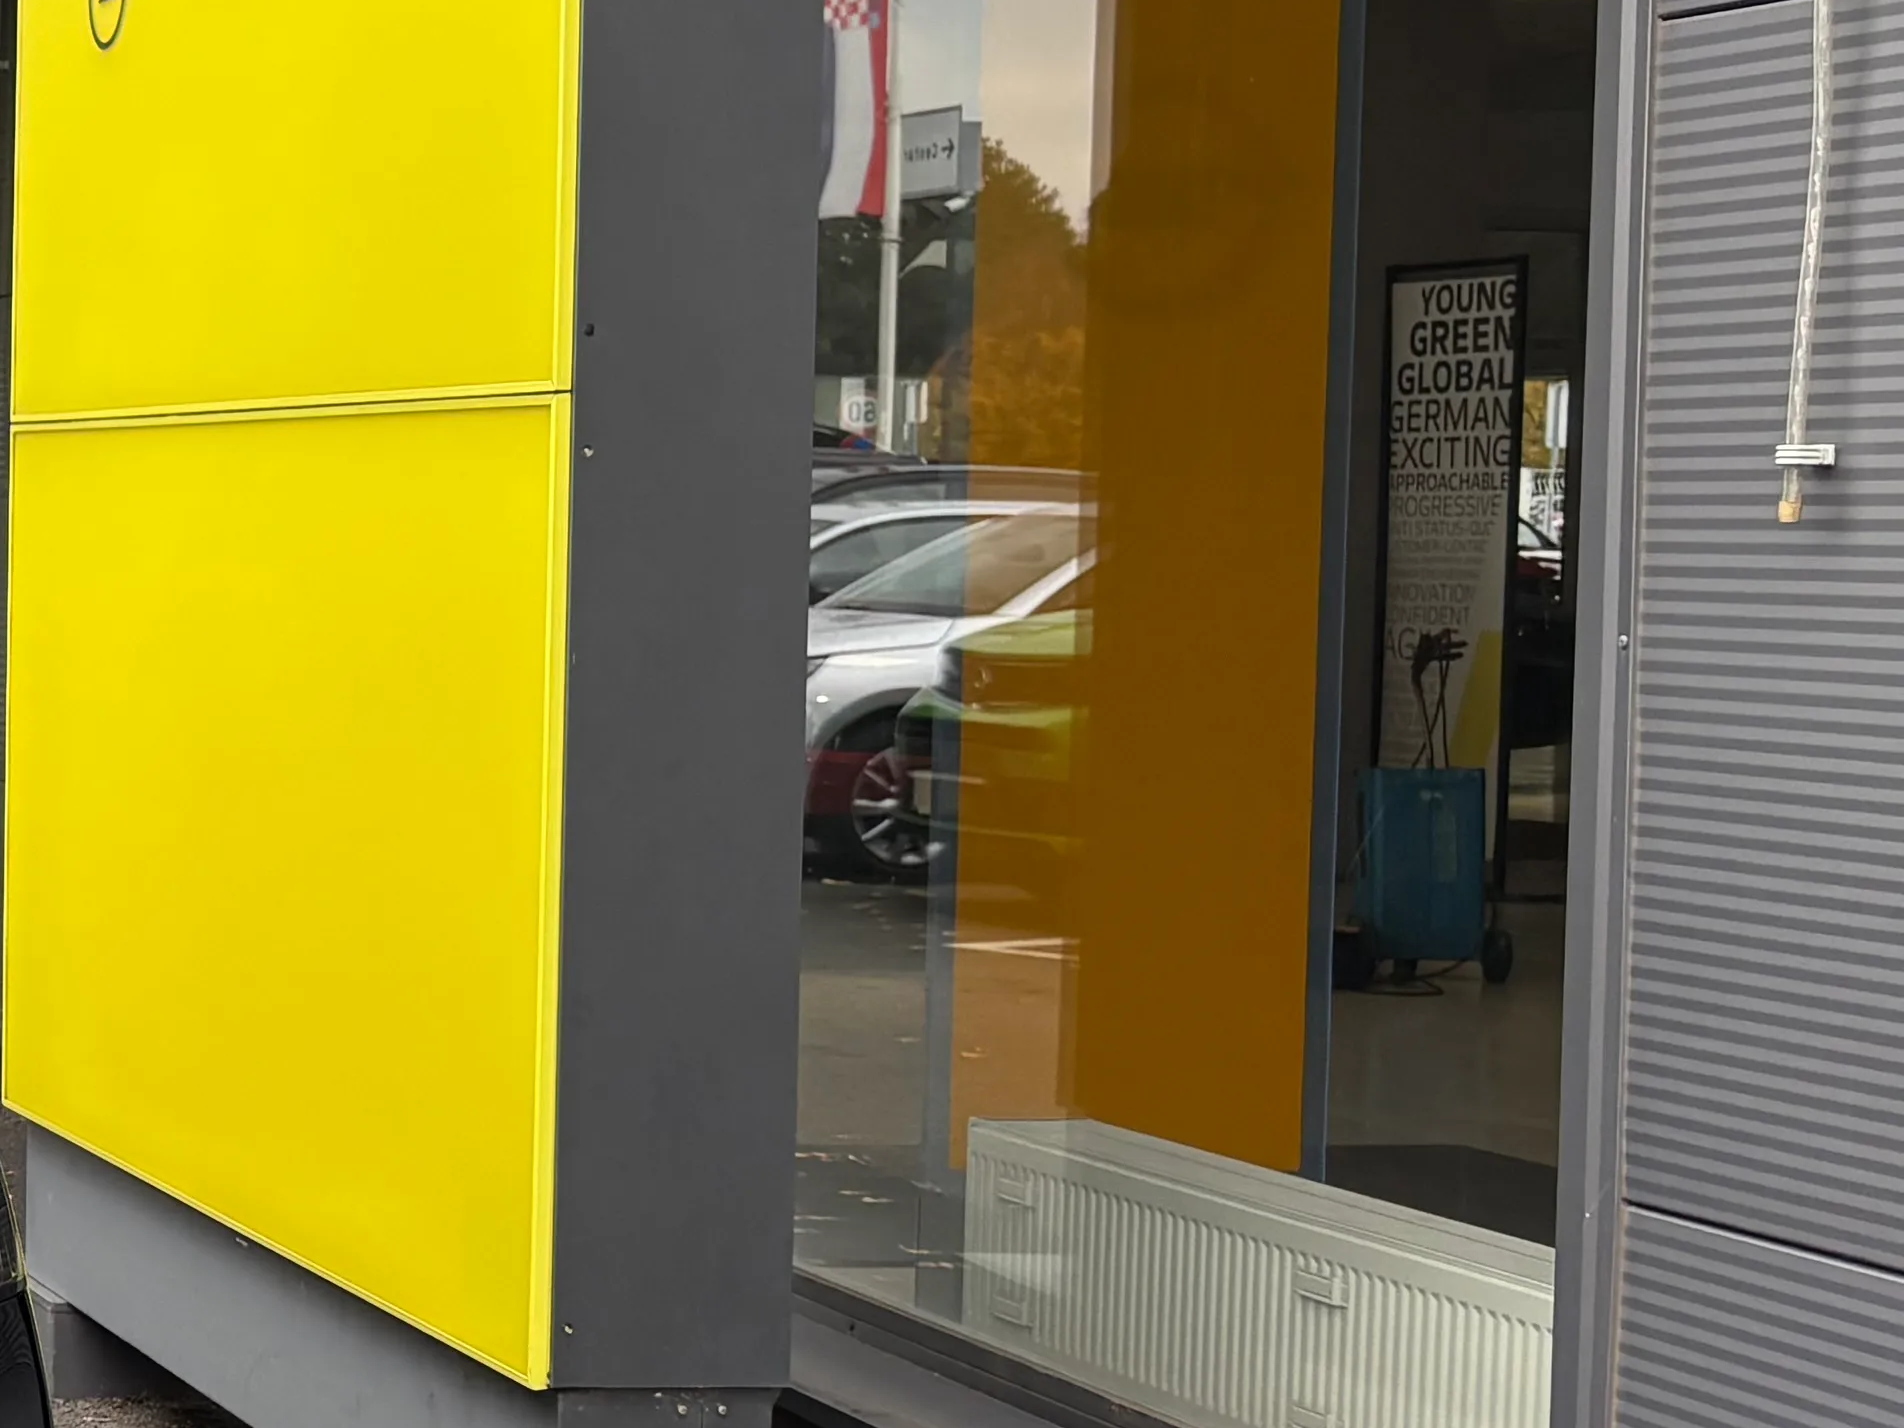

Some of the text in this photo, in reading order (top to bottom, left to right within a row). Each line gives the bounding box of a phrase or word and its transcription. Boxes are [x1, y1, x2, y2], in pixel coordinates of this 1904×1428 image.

[1421, 278, 1517, 317] YOUNG
[1409, 314, 1514, 358] GREEN
[1397, 356, 1513, 396] GLOBAL
[1391, 395, 1510, 434] GERMAN
[1390, 434, 1511, 470] EXCITING
[1390, 494, 1502, 518] ROGRESSIVE
[1386, 603, 1470, 625] ONFIDENT
